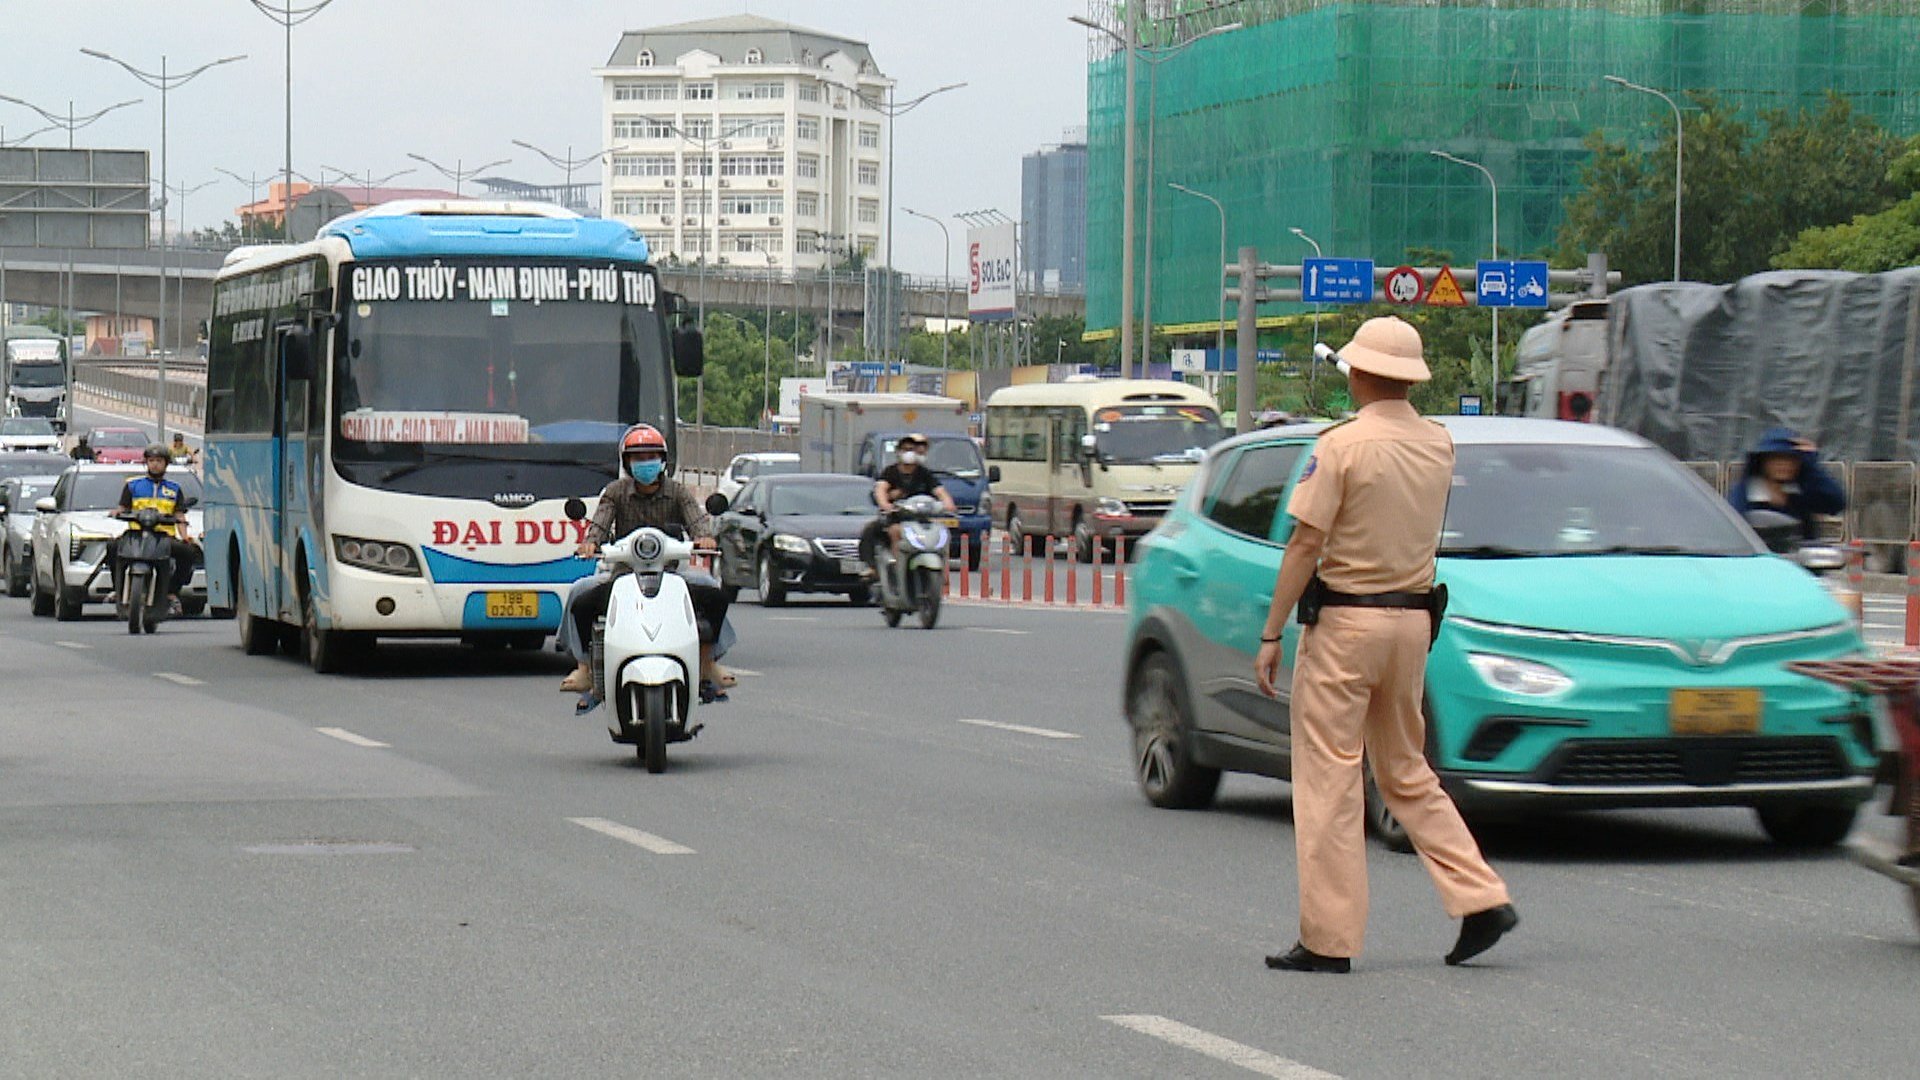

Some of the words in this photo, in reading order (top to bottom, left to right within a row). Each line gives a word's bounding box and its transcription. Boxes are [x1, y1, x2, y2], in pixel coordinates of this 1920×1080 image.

[352, 266, 400, 300] GIAO
[622, 270, 656, 312] THỌ
[493, 493, 536, 503] SAMCO
[432, 520, 503, 551] ĐẠI
